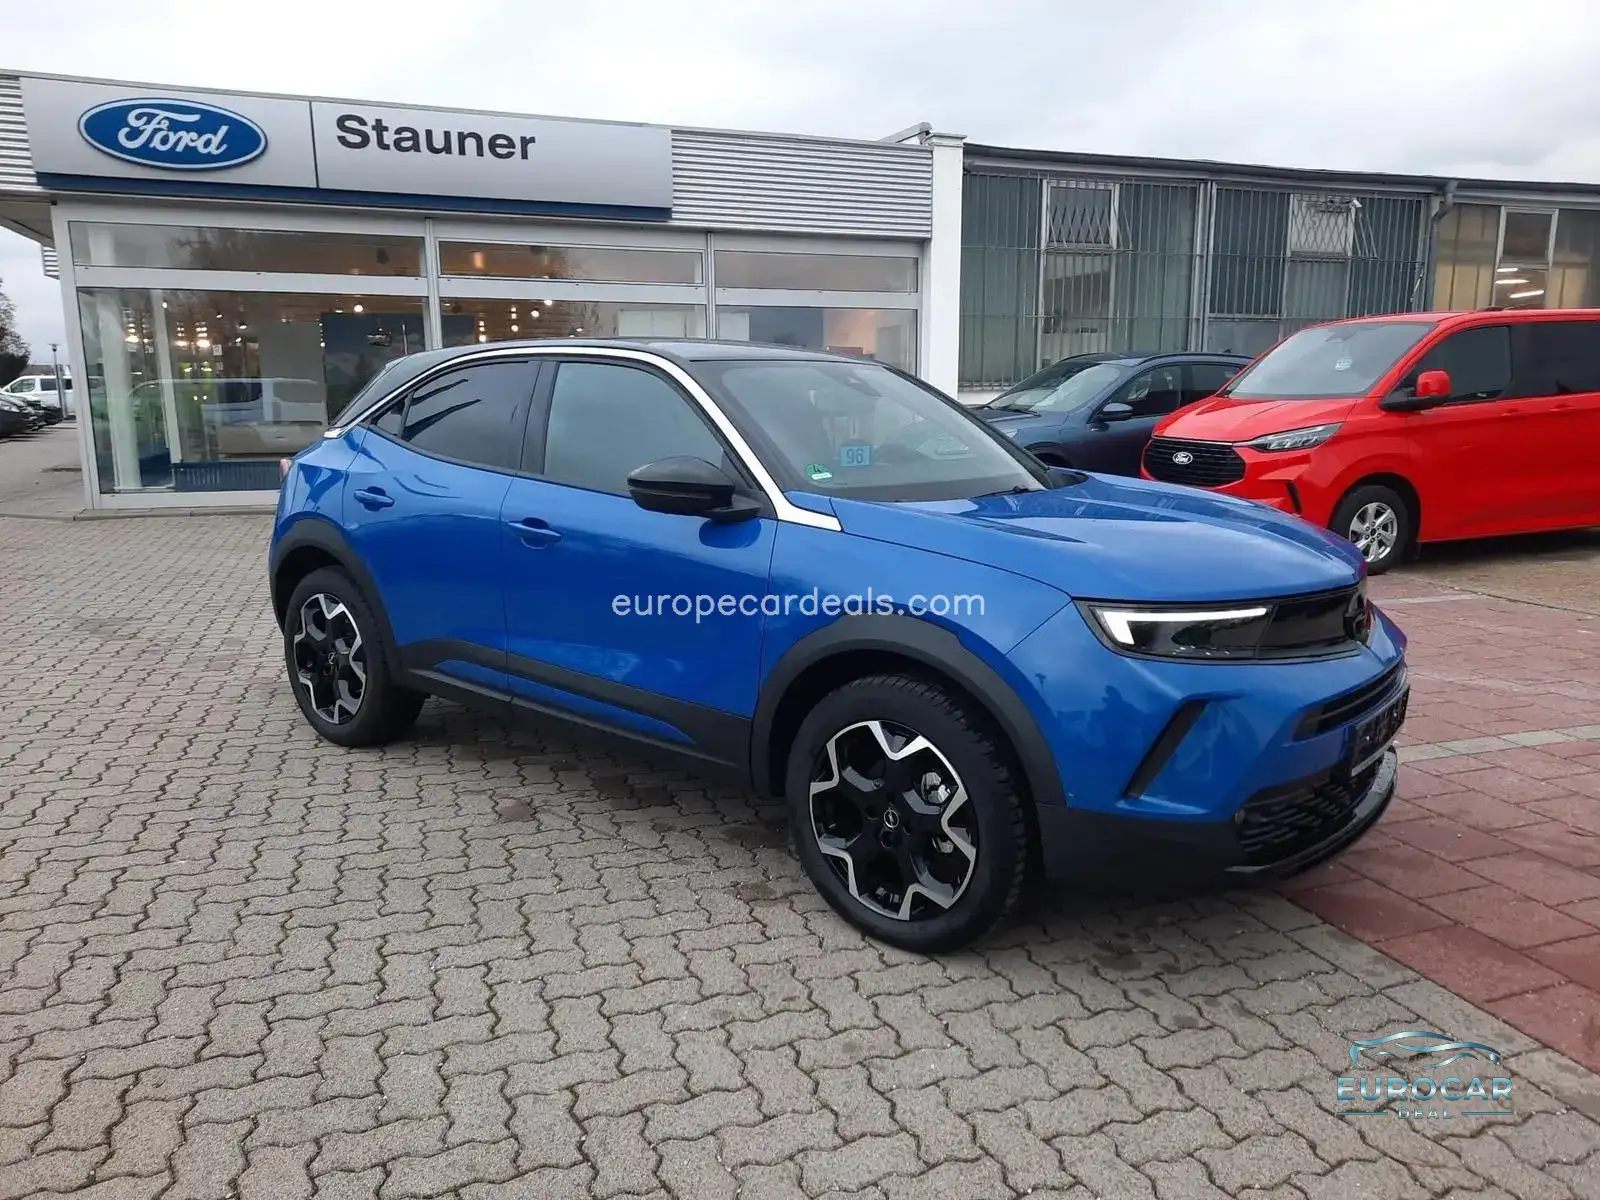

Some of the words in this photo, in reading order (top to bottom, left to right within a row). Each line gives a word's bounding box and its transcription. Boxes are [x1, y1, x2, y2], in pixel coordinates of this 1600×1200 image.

[118, 108, 229, 155] Ford
[336, 114, 536, 160] Stauner
[846, 448, 865, 464] 96
